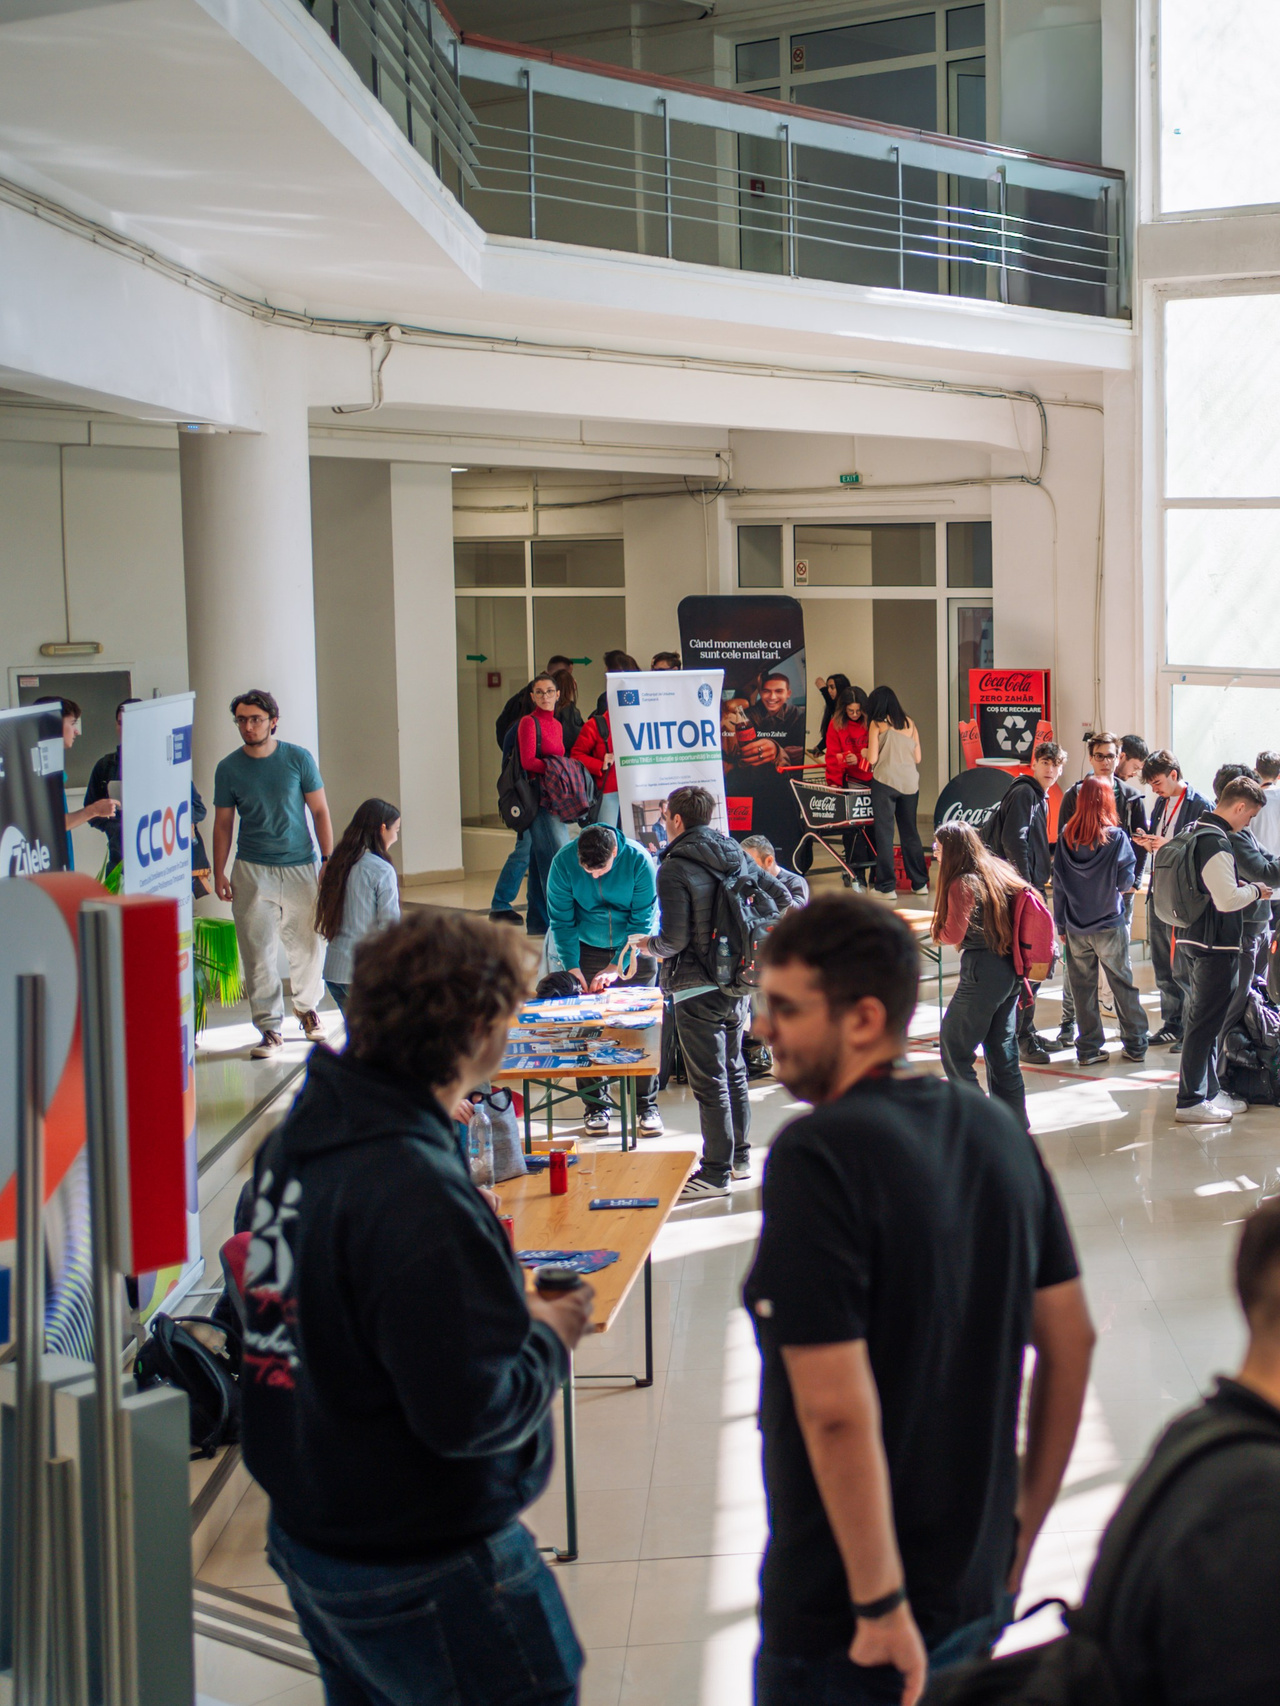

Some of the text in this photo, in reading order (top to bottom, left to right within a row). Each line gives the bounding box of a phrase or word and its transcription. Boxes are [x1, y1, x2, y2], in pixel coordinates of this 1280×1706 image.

[689, 639, 713, 649] Când
[714, 640, 768, 649] momentele
[769, 641, 781, 649] cu
[700, 650, 781, 659] sunt cele mai tari.
[623, 720, 717, 750] VIITOR
[855, 796, 872, 807] AD
[852, 807, 874, 818] ZER
[136, 800, 189, 868] CCOC
